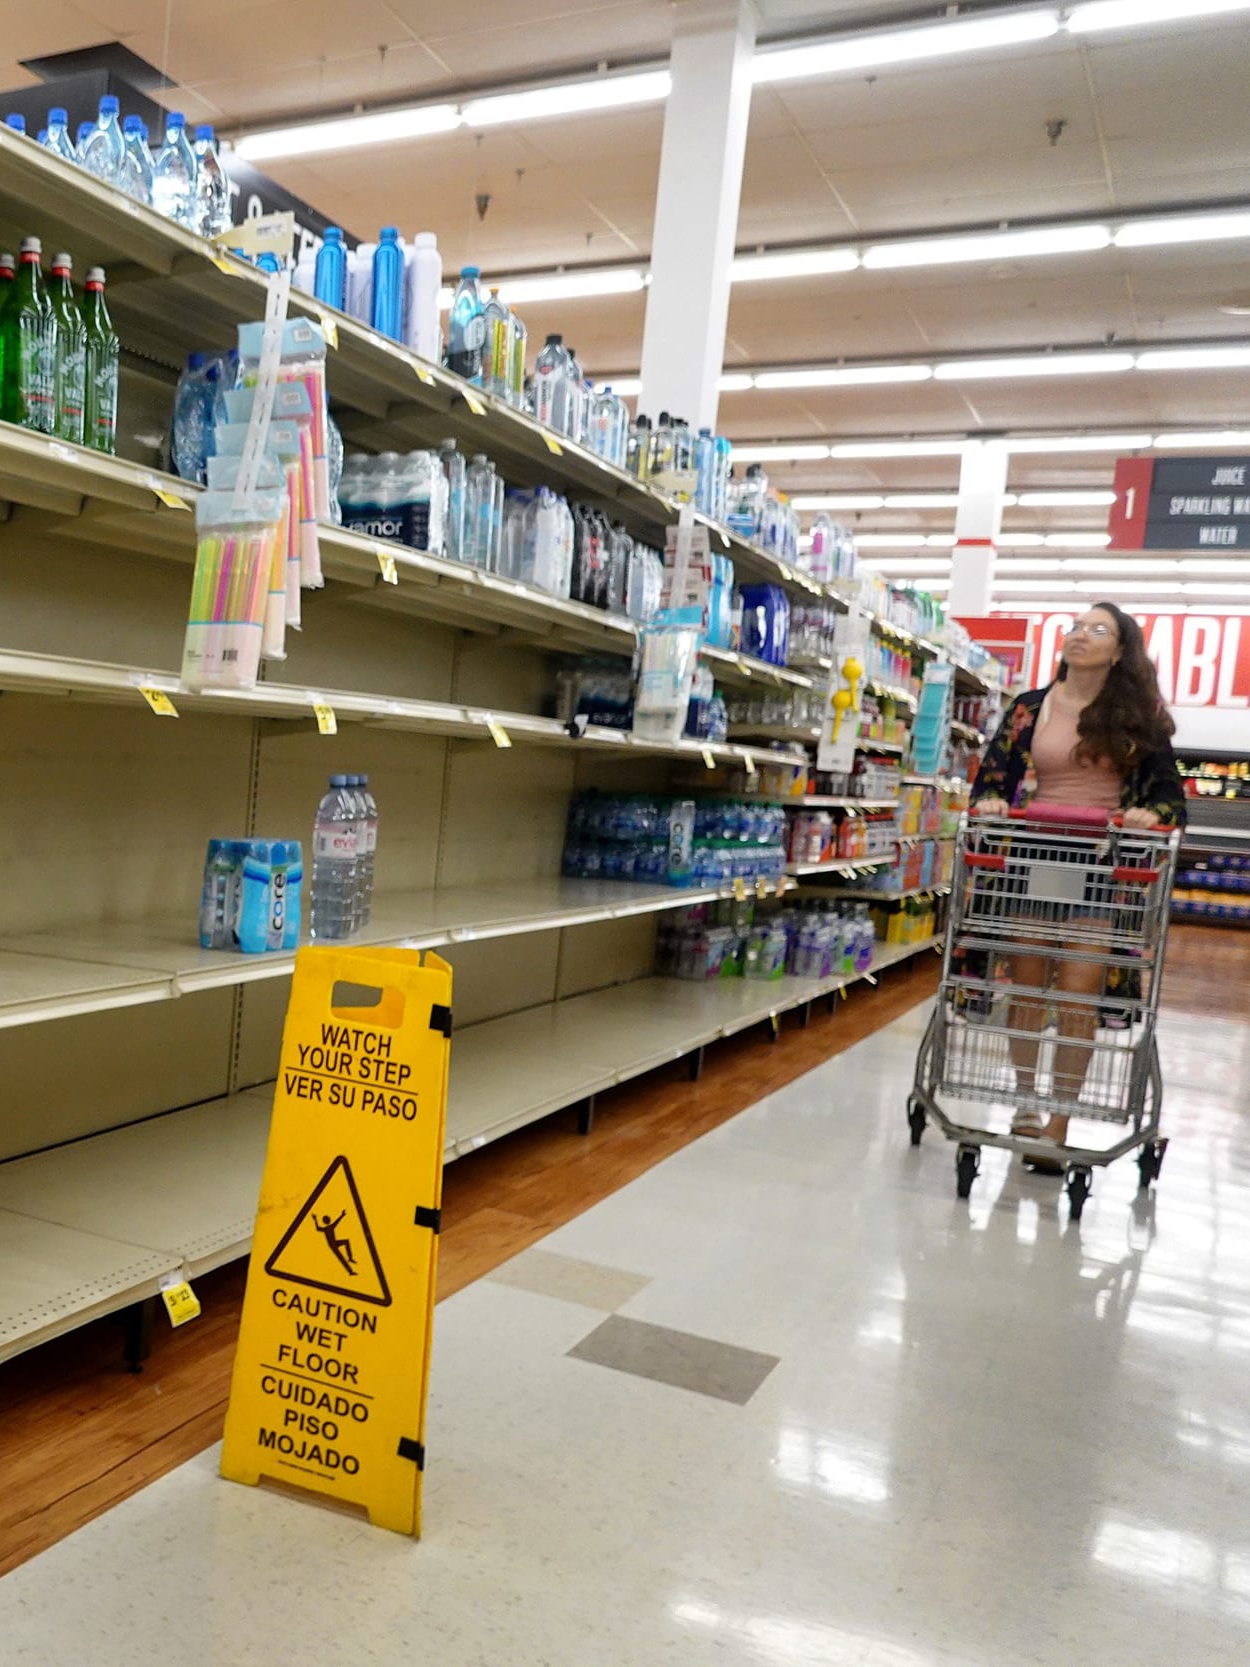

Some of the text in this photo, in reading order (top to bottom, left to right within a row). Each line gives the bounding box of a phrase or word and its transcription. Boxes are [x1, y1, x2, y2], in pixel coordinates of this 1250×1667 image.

[1125, 486, 1136, 520] 1
[1169, 496, 1231, 516] SPARKLING
[349, 519, 404, 537] amor
[272, 873, 286, 931] core
[321, 1023, 392, 1058] WATCH
[298, 1043, 412, 1087] YOUR STEP
[285, 1072, 417, 1121] VER SU PASO
[272, 1288, 378, 1334] CAUTION
[295, 1321, 348, 1352] WET
[278, 1344, 359, 1385] FLOOR
[261, 1375, 369, 1424] CUIDADO
[284, 1408, 339, 1441] PISO
[258, 1427, 360, 1476] MOJADO
